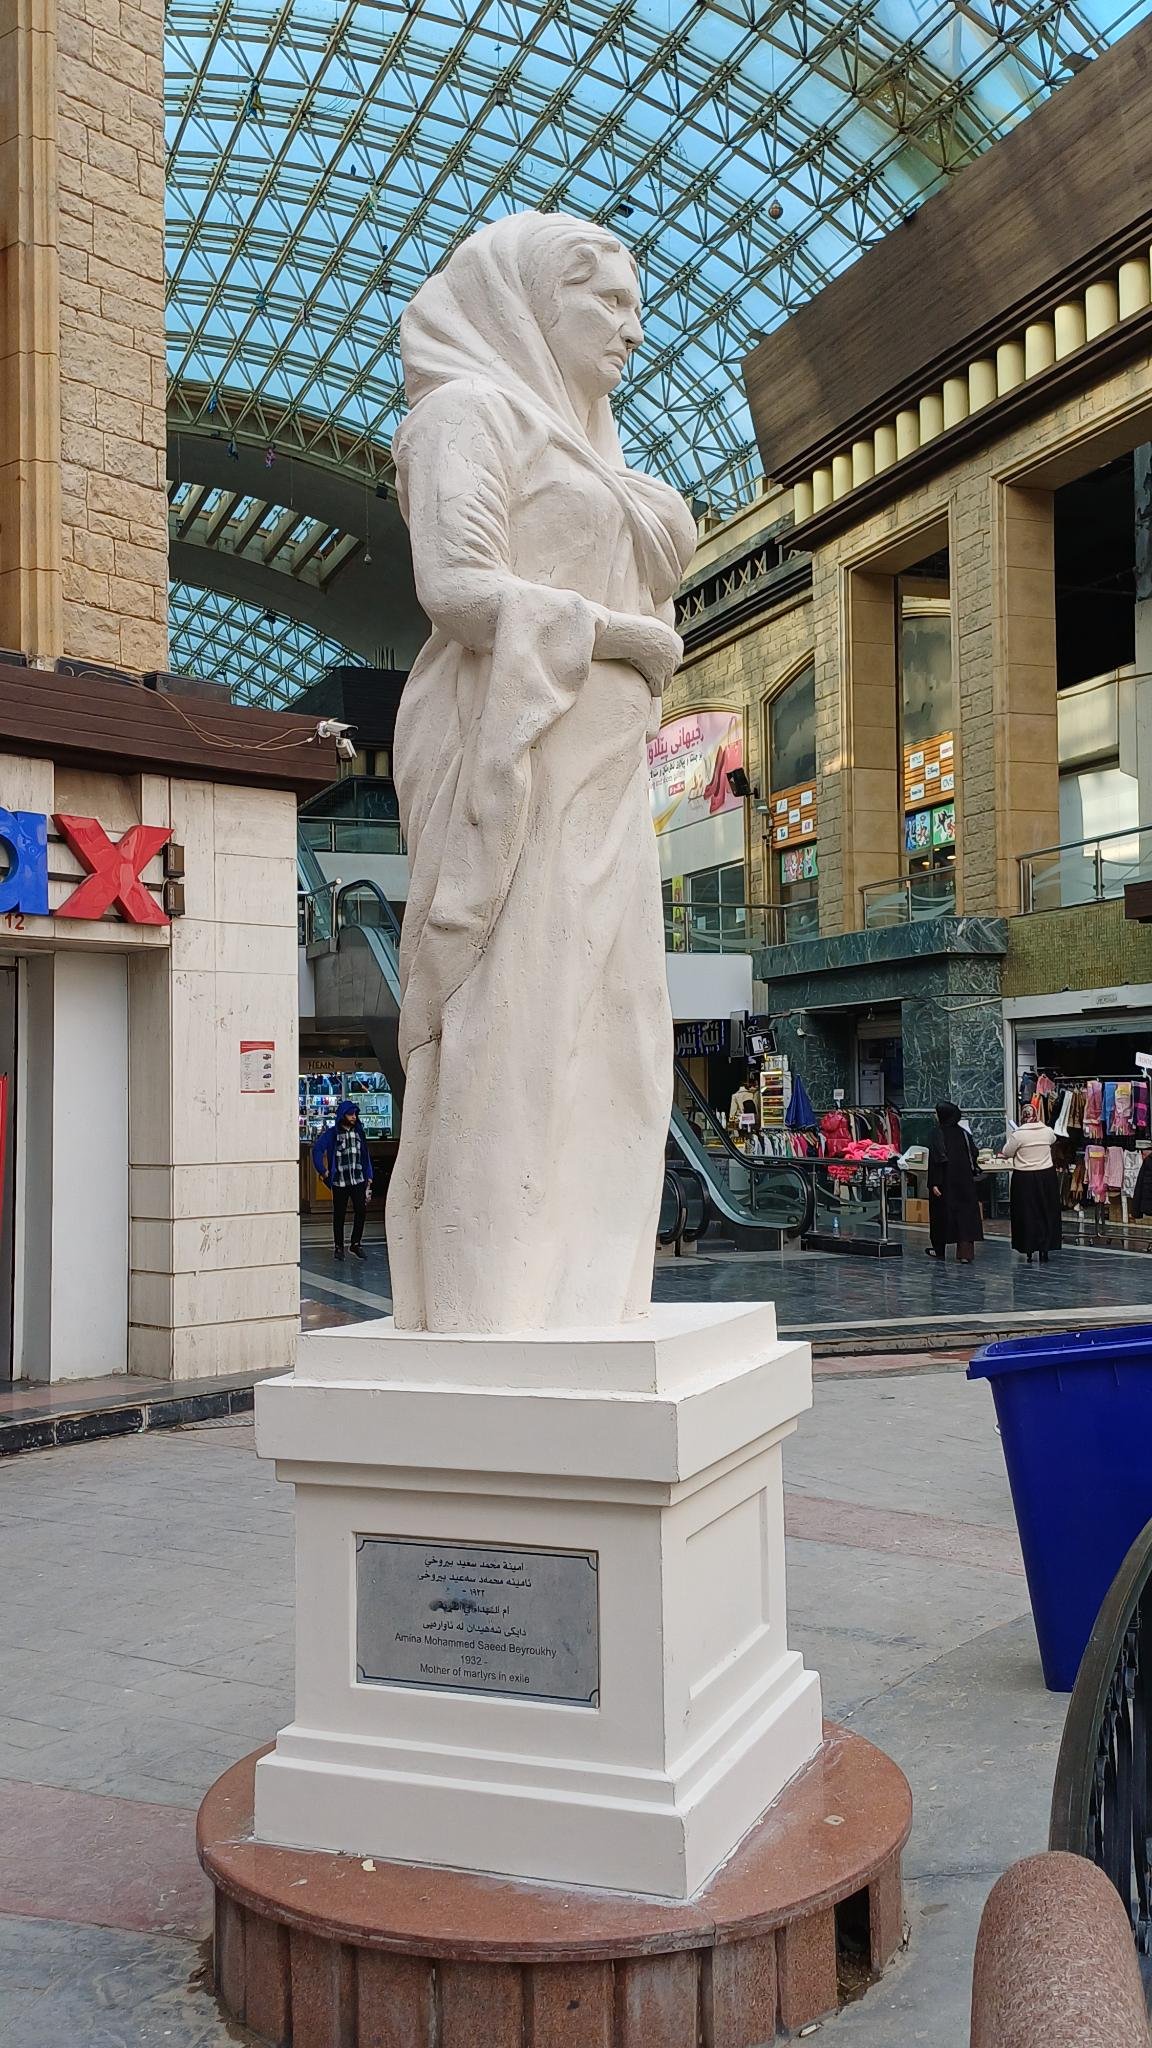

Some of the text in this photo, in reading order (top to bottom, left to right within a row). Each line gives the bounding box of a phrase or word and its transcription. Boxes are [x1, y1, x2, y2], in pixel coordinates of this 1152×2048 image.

[394, 1632, 557, 1659] Amina Mohammed Saeed Beyroukhy
[460, 1655, 482, 1666] 1932
[420, 1663, 531, 1685] Mother of martyrs in exile
